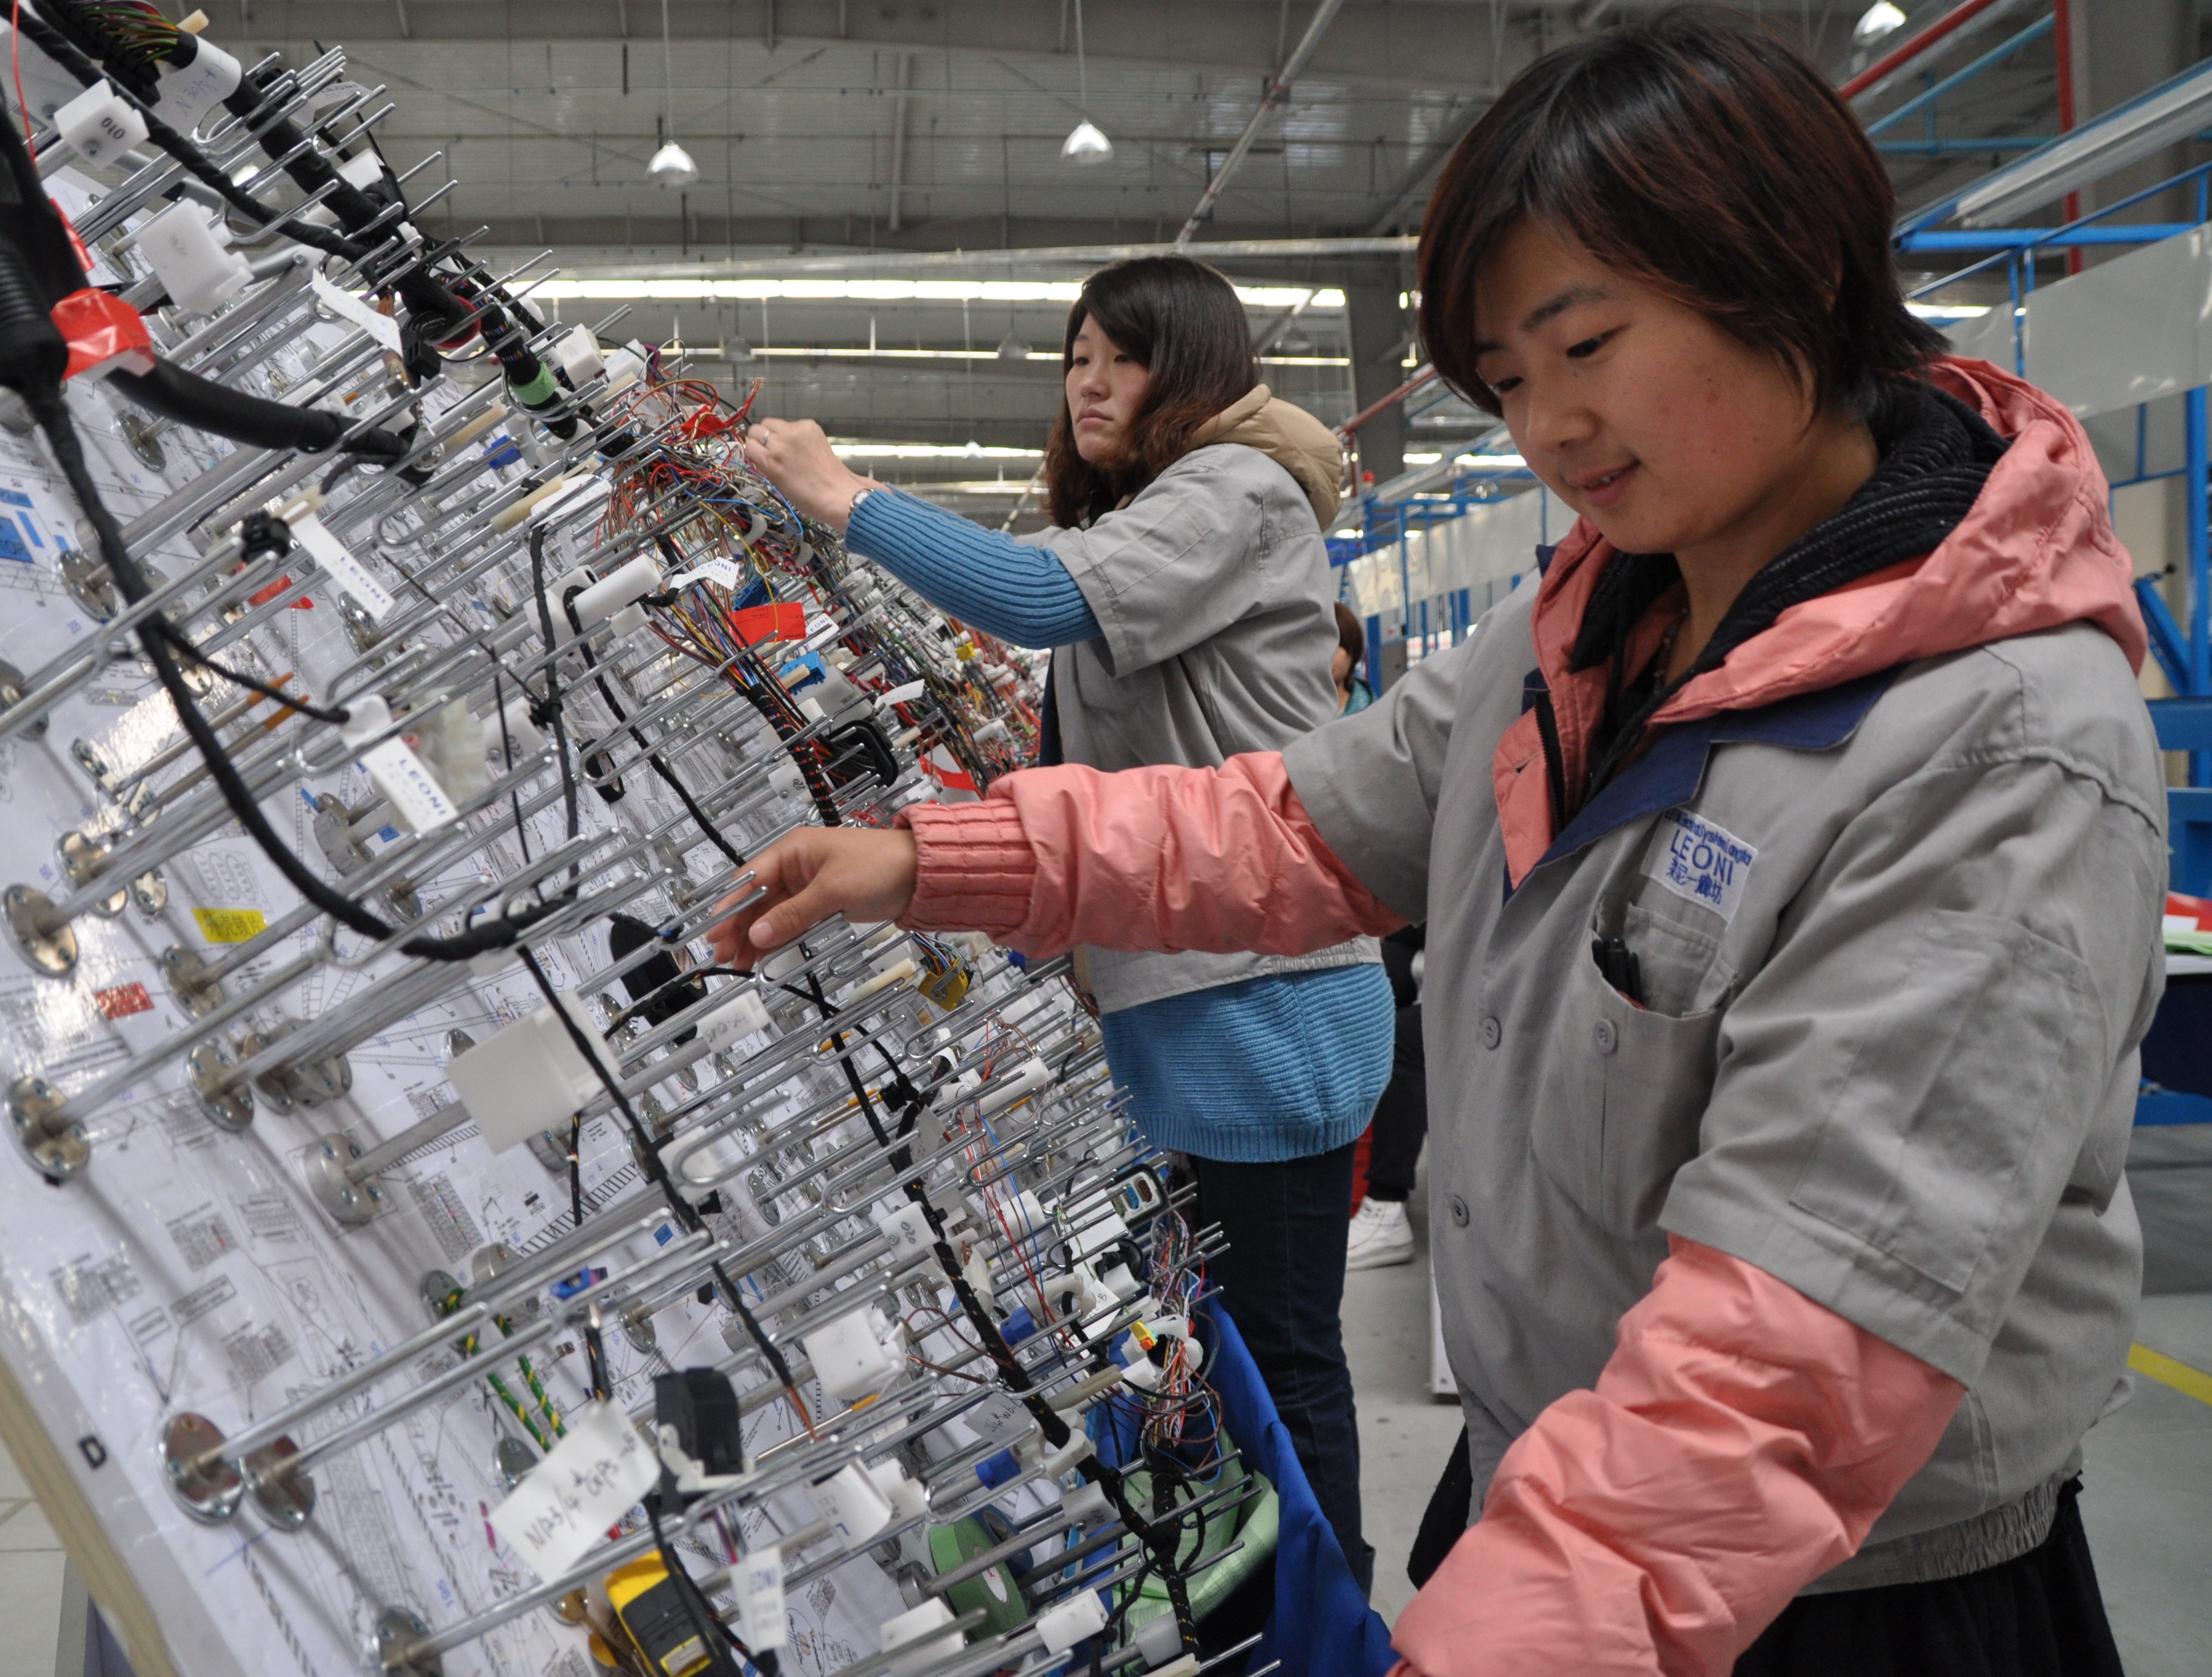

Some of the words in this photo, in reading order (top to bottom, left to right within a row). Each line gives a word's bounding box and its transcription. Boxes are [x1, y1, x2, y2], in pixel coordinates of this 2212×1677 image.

[101, 117, 126, 139] 010
[399, 759, 447, 817] LEONI
[1670, 828, 1733, 887] LEONI
[77, 1434, 107, 1471] D
